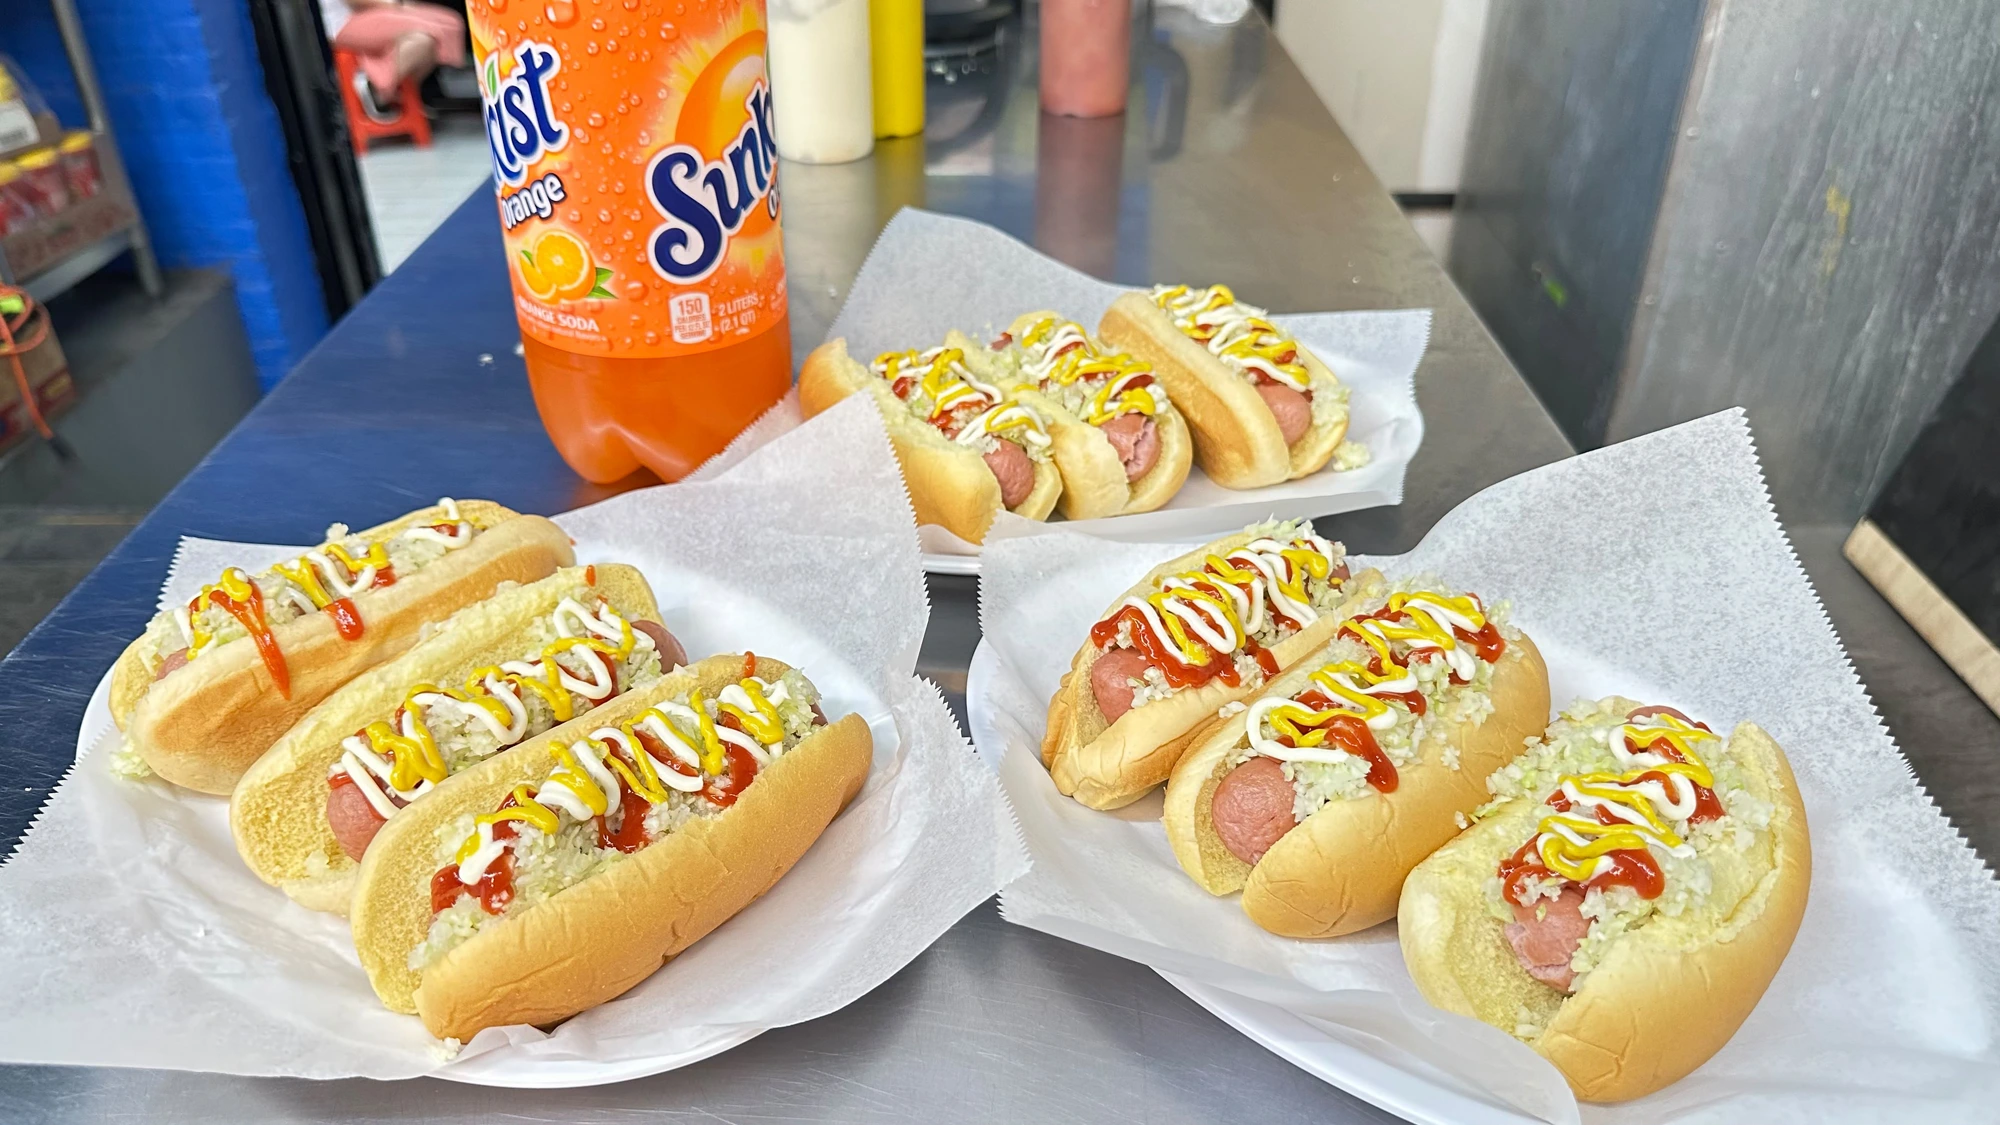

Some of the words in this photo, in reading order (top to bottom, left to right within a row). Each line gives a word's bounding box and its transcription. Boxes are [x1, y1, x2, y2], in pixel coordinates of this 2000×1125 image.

[502, 173, 565, 231] orange
[678, 298, 703, 316] 150
[719, 304, 726, 316] 2
[727, 292, 759, 314] LITERS
[557, 314, 600, 332] SODA
